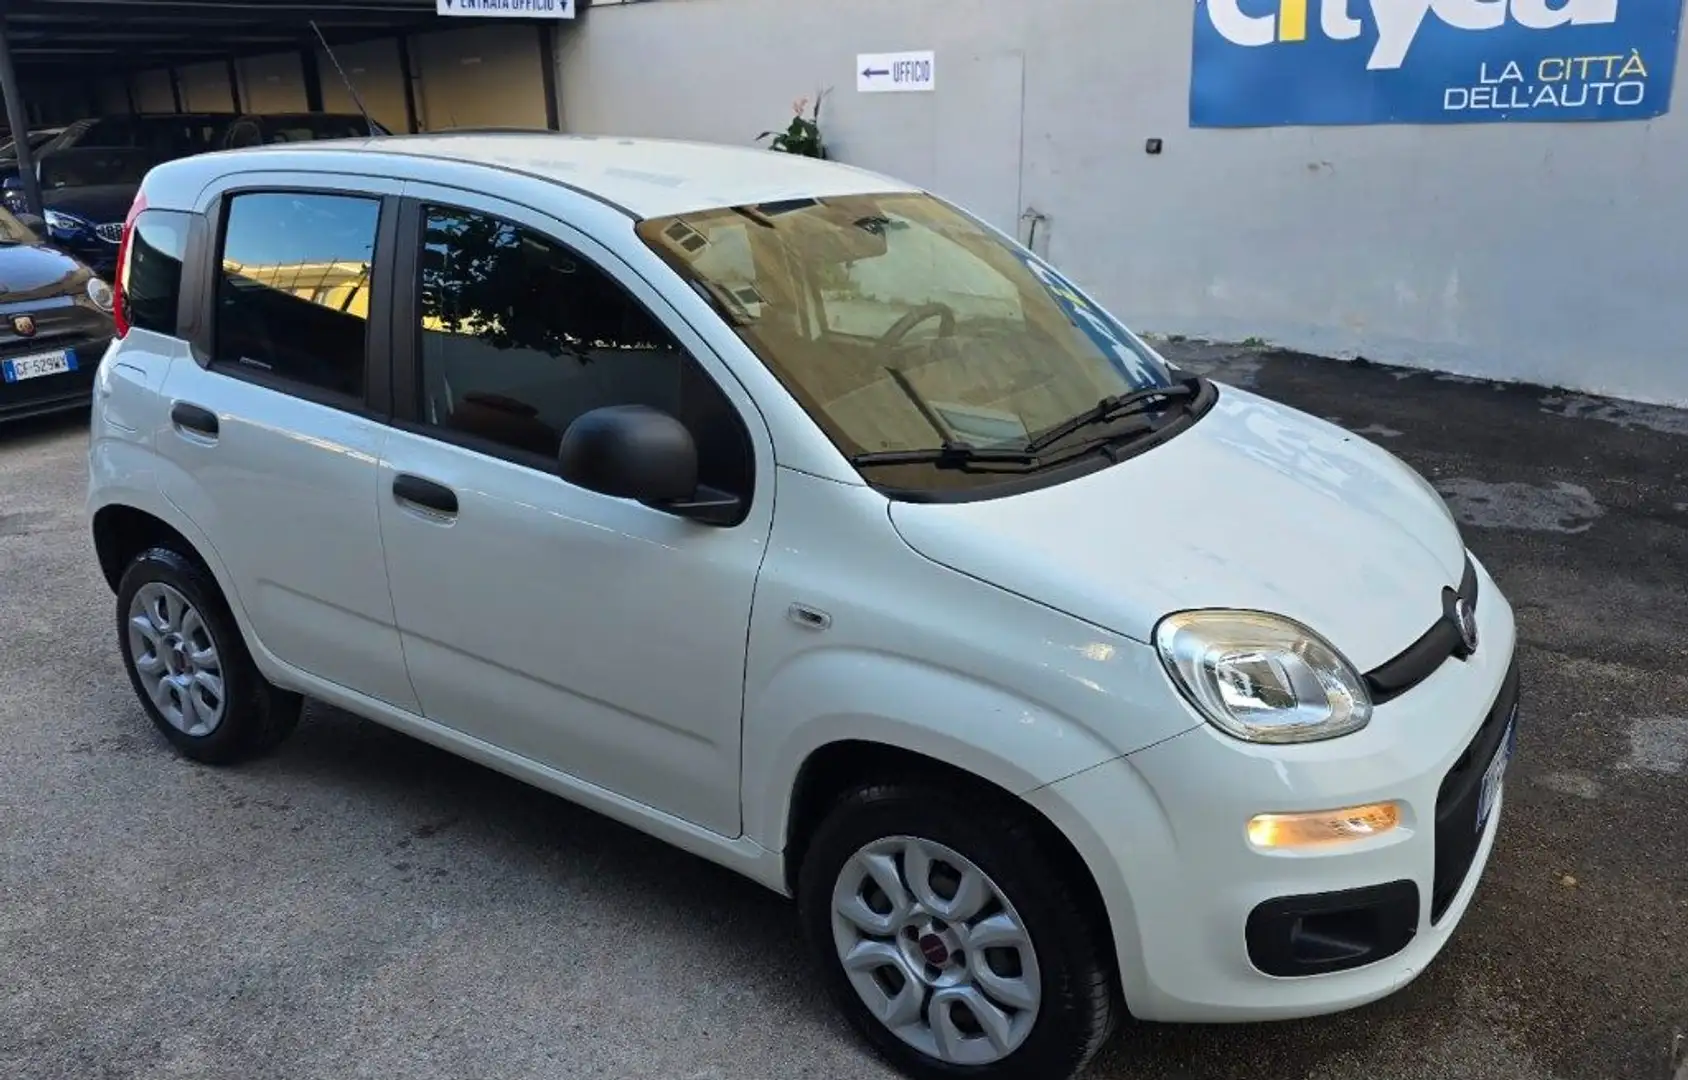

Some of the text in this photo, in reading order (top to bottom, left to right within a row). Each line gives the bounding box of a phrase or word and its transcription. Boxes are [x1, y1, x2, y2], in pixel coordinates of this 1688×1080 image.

[892, 59, 931, 82] UFFICIO
[1480, 48, 1648, 84] LA CITTÀ
[1443, 81, 1645, 110] DELL'AUTO
